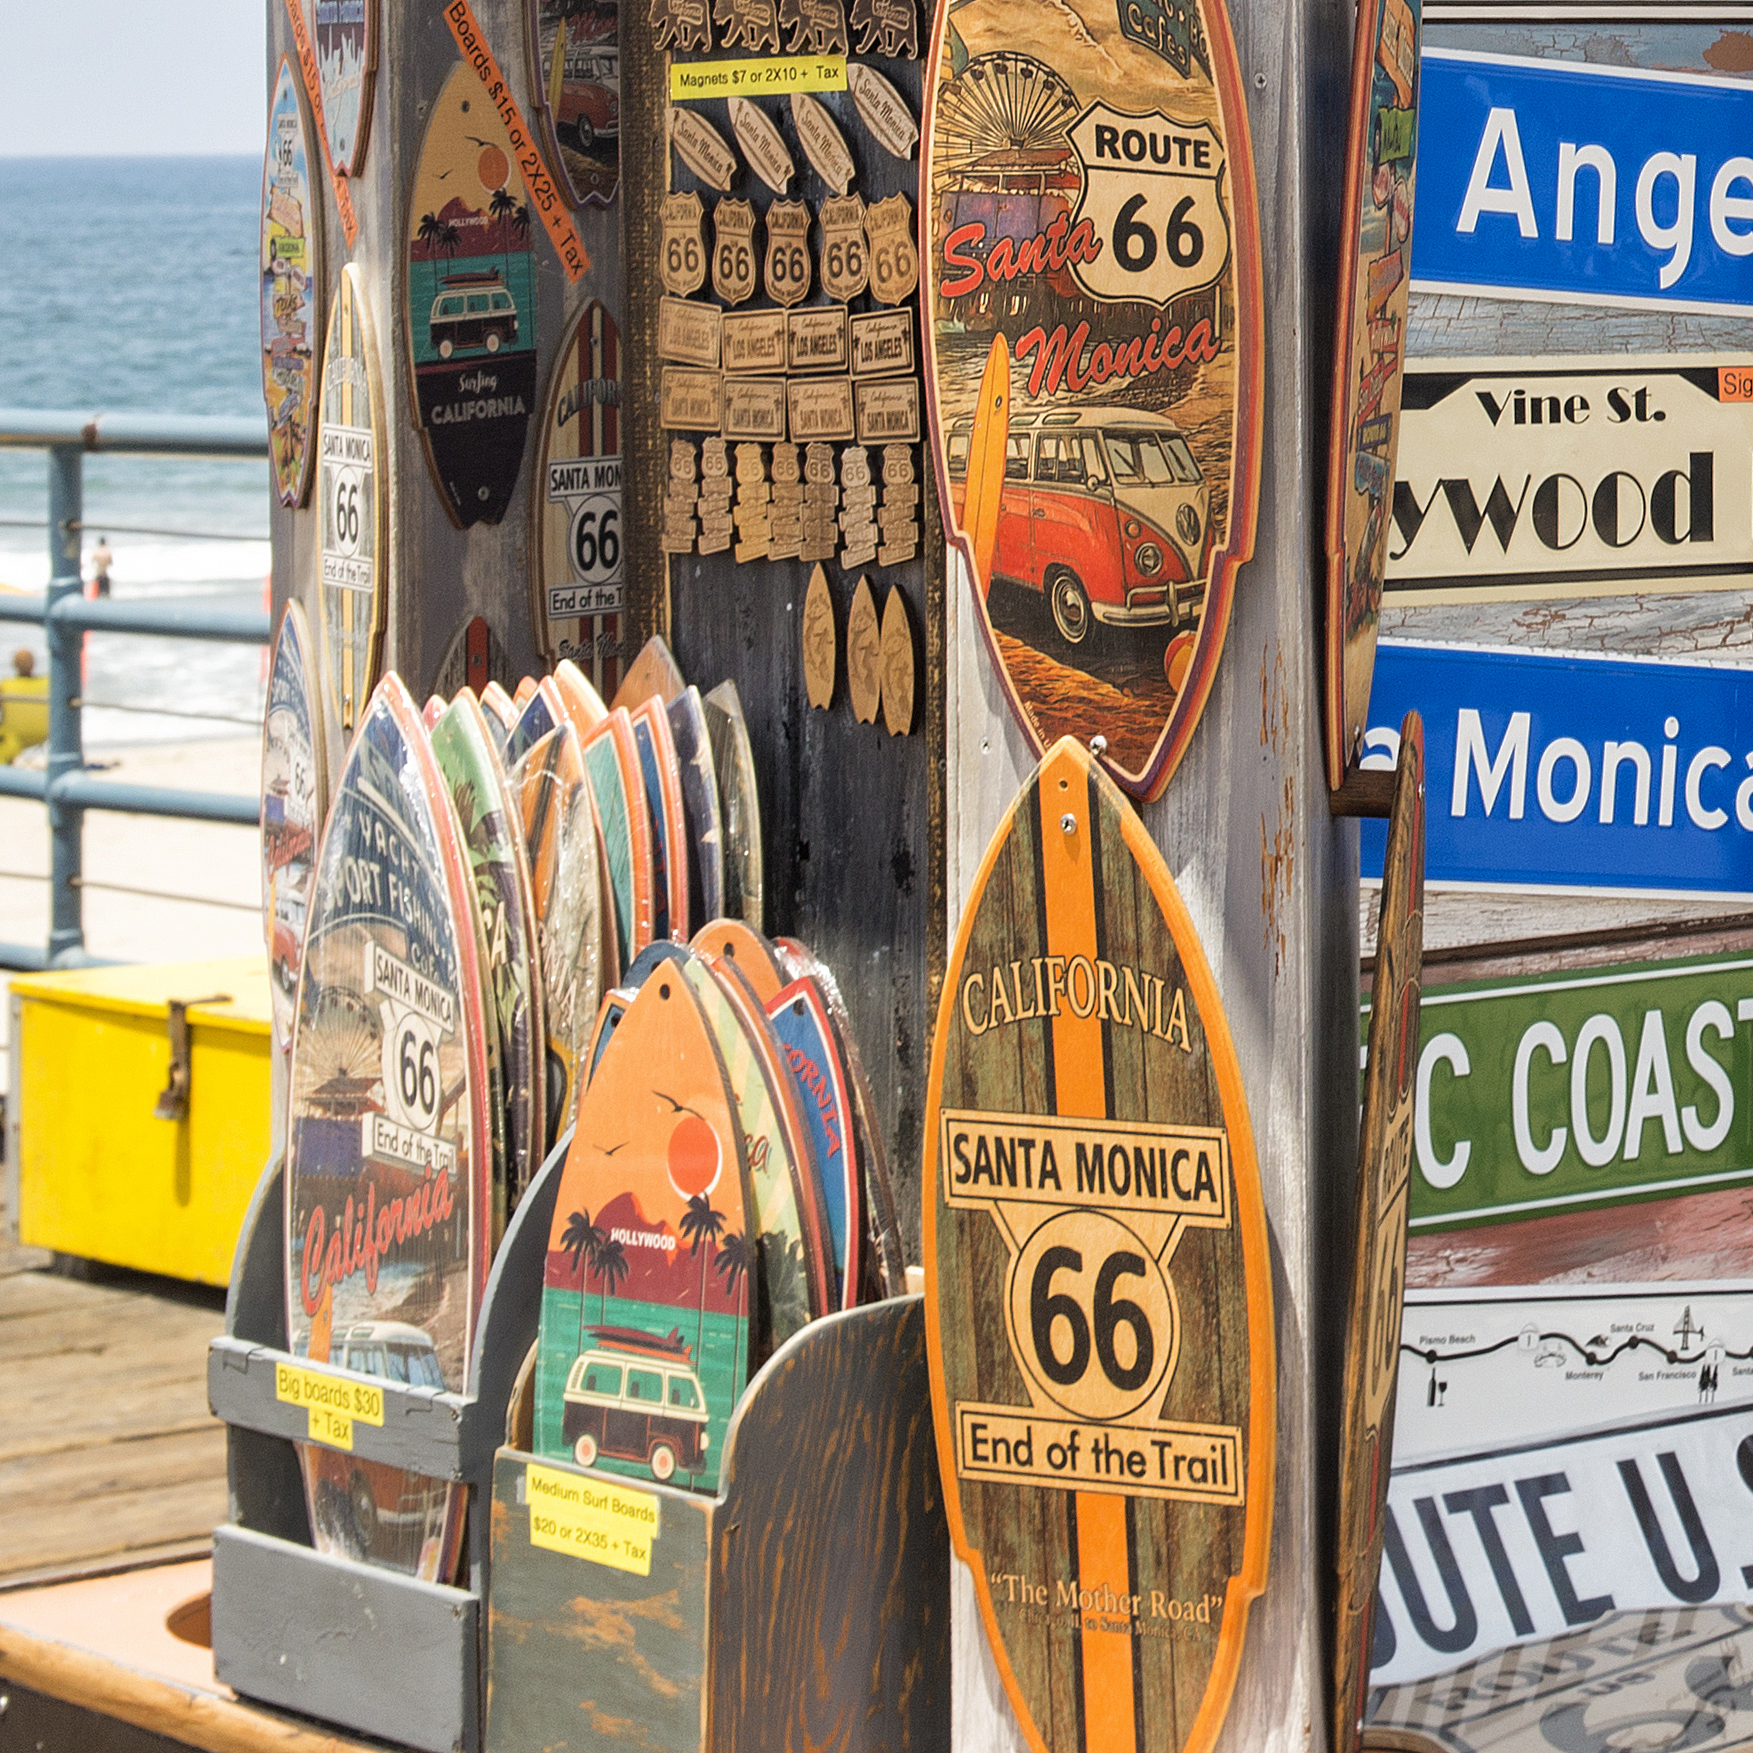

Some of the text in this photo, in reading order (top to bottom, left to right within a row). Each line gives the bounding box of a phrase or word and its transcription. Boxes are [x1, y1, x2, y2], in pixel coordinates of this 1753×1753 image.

[679, 64, 840, 90] Magnets $7 or 2X10 Tax
[447, 0, 586, 276] Boards or Tax
[1094, 124, 1213, 170] ROUTE
[447, 214, 489, 229] HOLLYWOOD
[1112, 192, 1204, 274] 66
[667, 236, 700, 273] 66
[718, 243, 751, 282] 66
[771, 245, 805, 284] 66
[826, 239, 863, 279] 66
[875, 242, 912, 285] 66
[940, 212, 1105, 299] Santa
[1014, 317, 1222, 397] Monica
[458, 373, 498, 394] Surfing
[1475, 386, 1667, 427] Vine St.
[431, 395, 526, 425] CALIFORNIA
[550, 464, 590, 493] SANTA
[336, 481, 359, 546] 66
[575, 508, 620, 573] 66
[552, 588, 615, 611] End the
[375, 952, 410, 997] SANTA
[414, 974, 454, 1024] MONICA
[961, 954, 1193, 1053] CALIFORNIA
[400, 1030, 437, 1115] 66
[377, 1122, 399, 1150] End
[953, 1133, 1218, 1204] SANTA MONICA
[302, 1163, 454, 1317] California
[610, 1227, 677, 1251] HOLLYWOOD
[1029, 1245, 1155, 1392] 66
[278, 1368, 381, 1418] Big boards $30
[323, 1412, 351, 1440] Tax
[970, 1422, 1229, 1487] End of the Trail
[530, 1476, 656, 1525] Medium Surf Boards
[533, 1516, 648, 1562] $20 2X35 Tax
[1055, 1578, 1142, 1617] Mother
